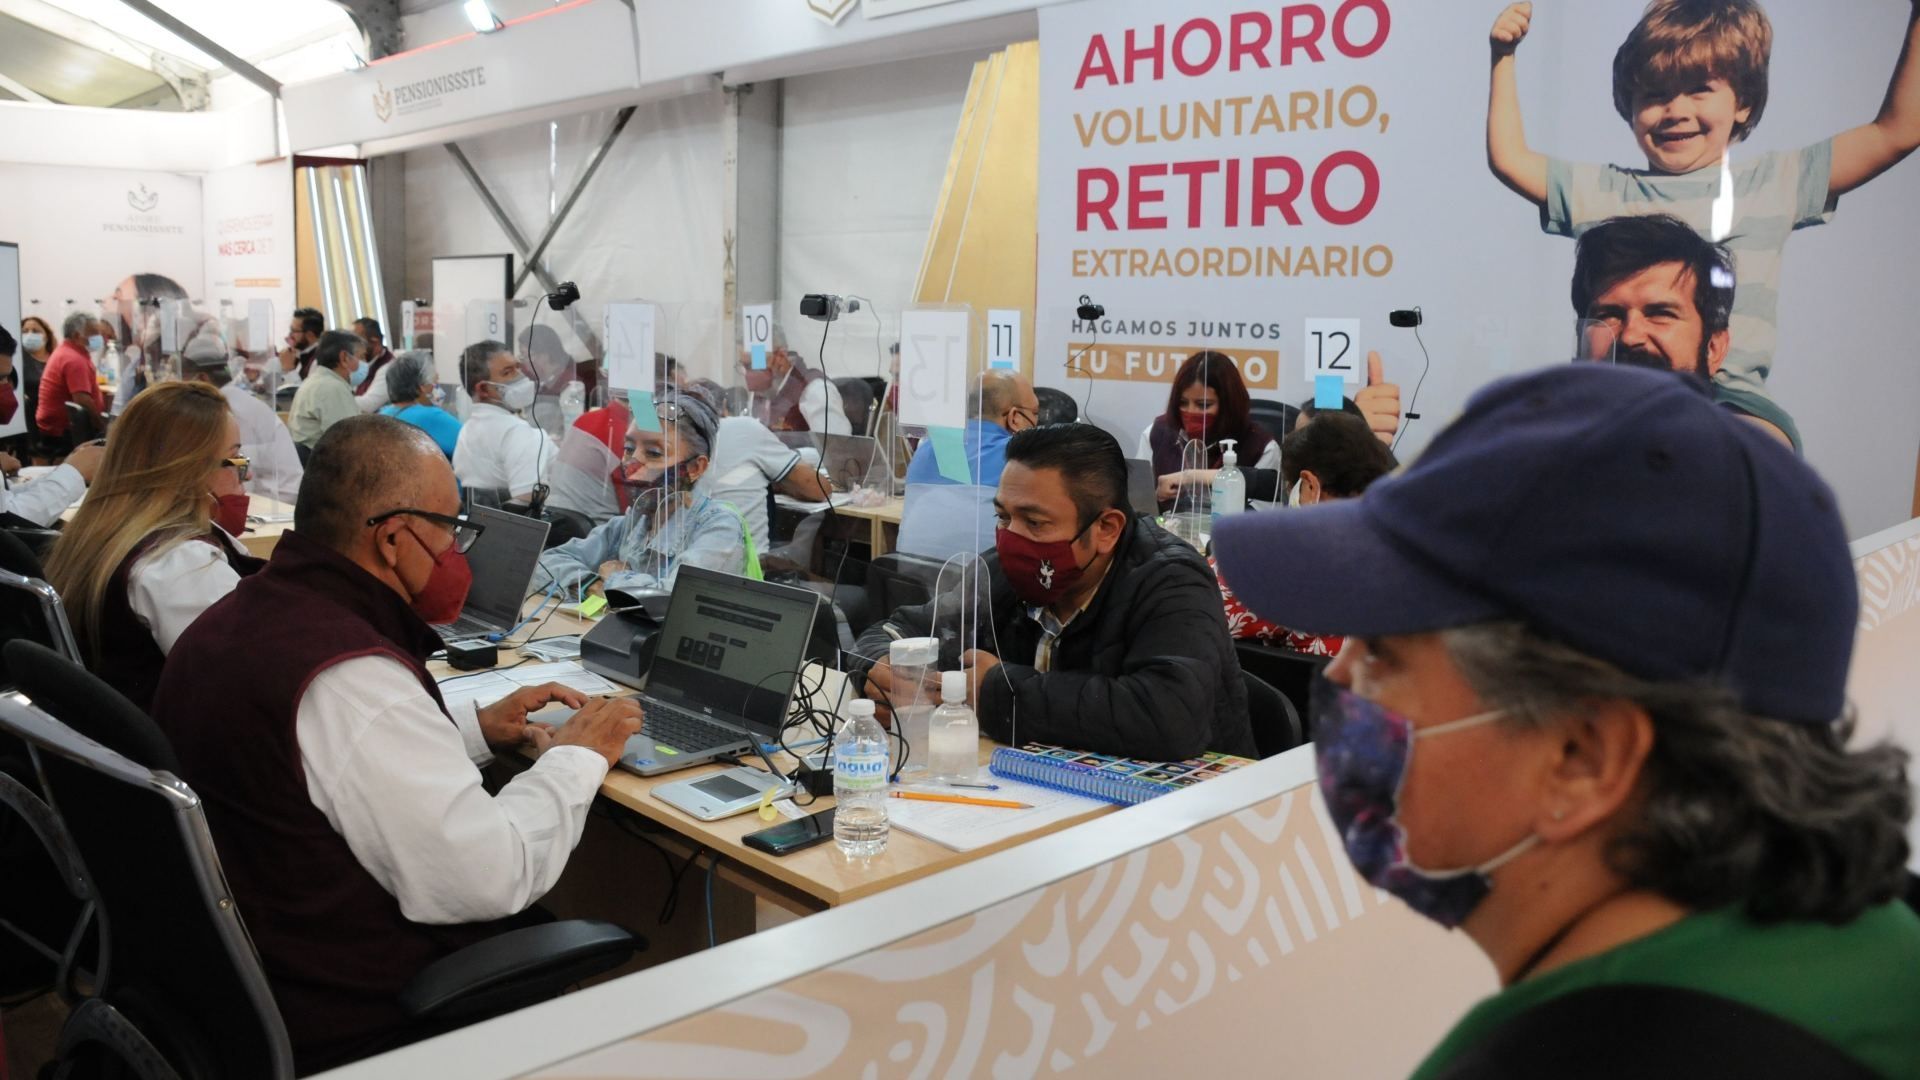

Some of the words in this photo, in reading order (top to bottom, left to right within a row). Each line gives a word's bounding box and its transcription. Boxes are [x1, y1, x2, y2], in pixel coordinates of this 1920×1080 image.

[1074, 0, 1391, 90] AHORRO
[394, 66, 486, 105] PENSIONISSSTE
[1073, 84, 1390, 148] VOLUNTARIO,
[1076, 150, 1380, 232] RETIRO
[1072, 244, 1393, 278] EXTRAORDINARIO
[489, 312, 498, 335] 8
[745, 314, 769, 342] 10
[991, 323, 1012, 357] 11
[1071, 318, 1177, 336] HAGAMOS
[1187, 321, 1280, 340] JUNTOS
[1070, 349, 1108, 374] TU
[1124, 350, 1268, 384] FUTO
[1310, 330, 1352, 370] 12
[837, 761, 882, 777] agua
